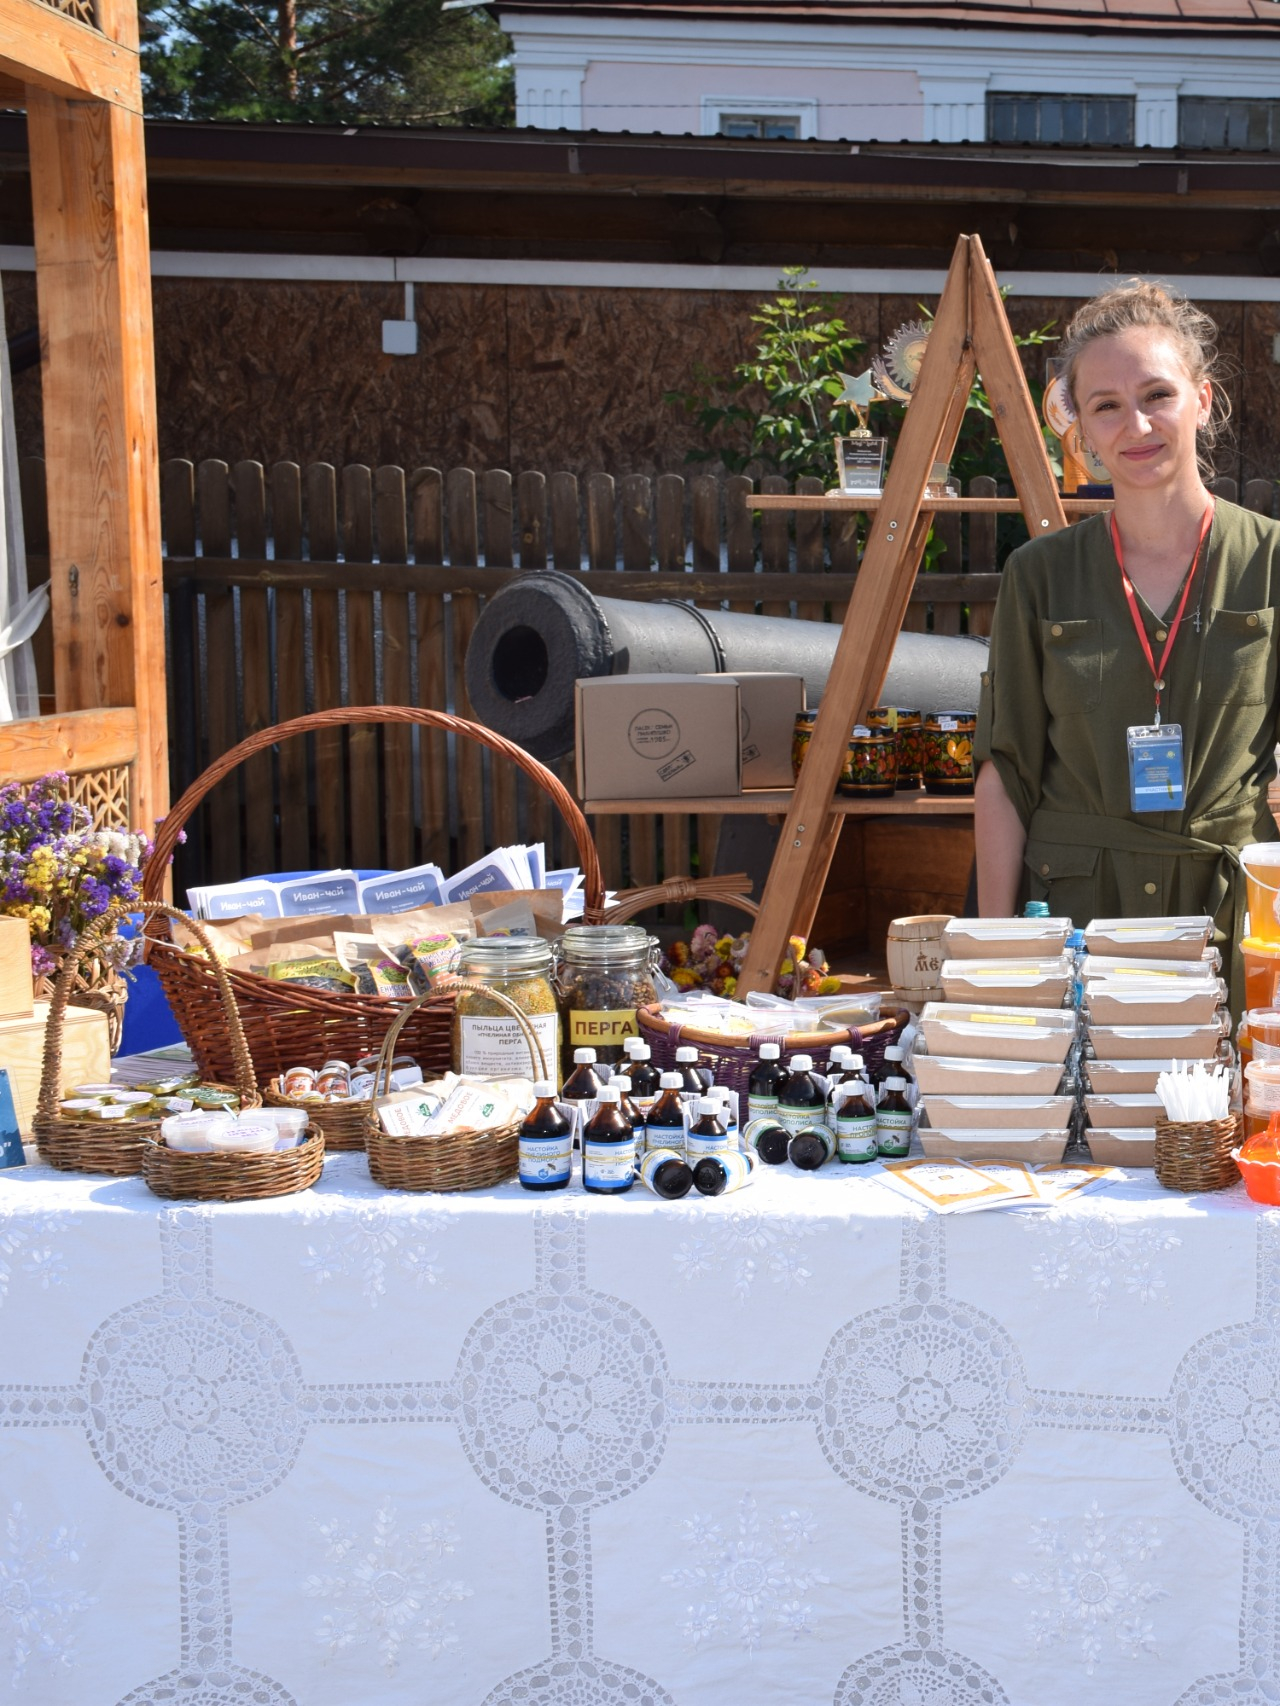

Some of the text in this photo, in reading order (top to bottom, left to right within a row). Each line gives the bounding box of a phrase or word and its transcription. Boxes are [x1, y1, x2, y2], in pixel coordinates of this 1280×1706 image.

[293, 886, 344, 902] Иван-чай
[375, 882, 426, 900] Иван-чай
[220, 896, 265, 911] Иван-чай
[915, 957, 943, 971] МЁ
[472, 1024, 504, 1032] ПЫЛЬЦА
[575, 1021, 634, 1035] ПЕРГА
[447, 1092, 473, 1124] МЕДОВОЕ
[394, 1107, 411, 1136] ЕДОВОЕ
